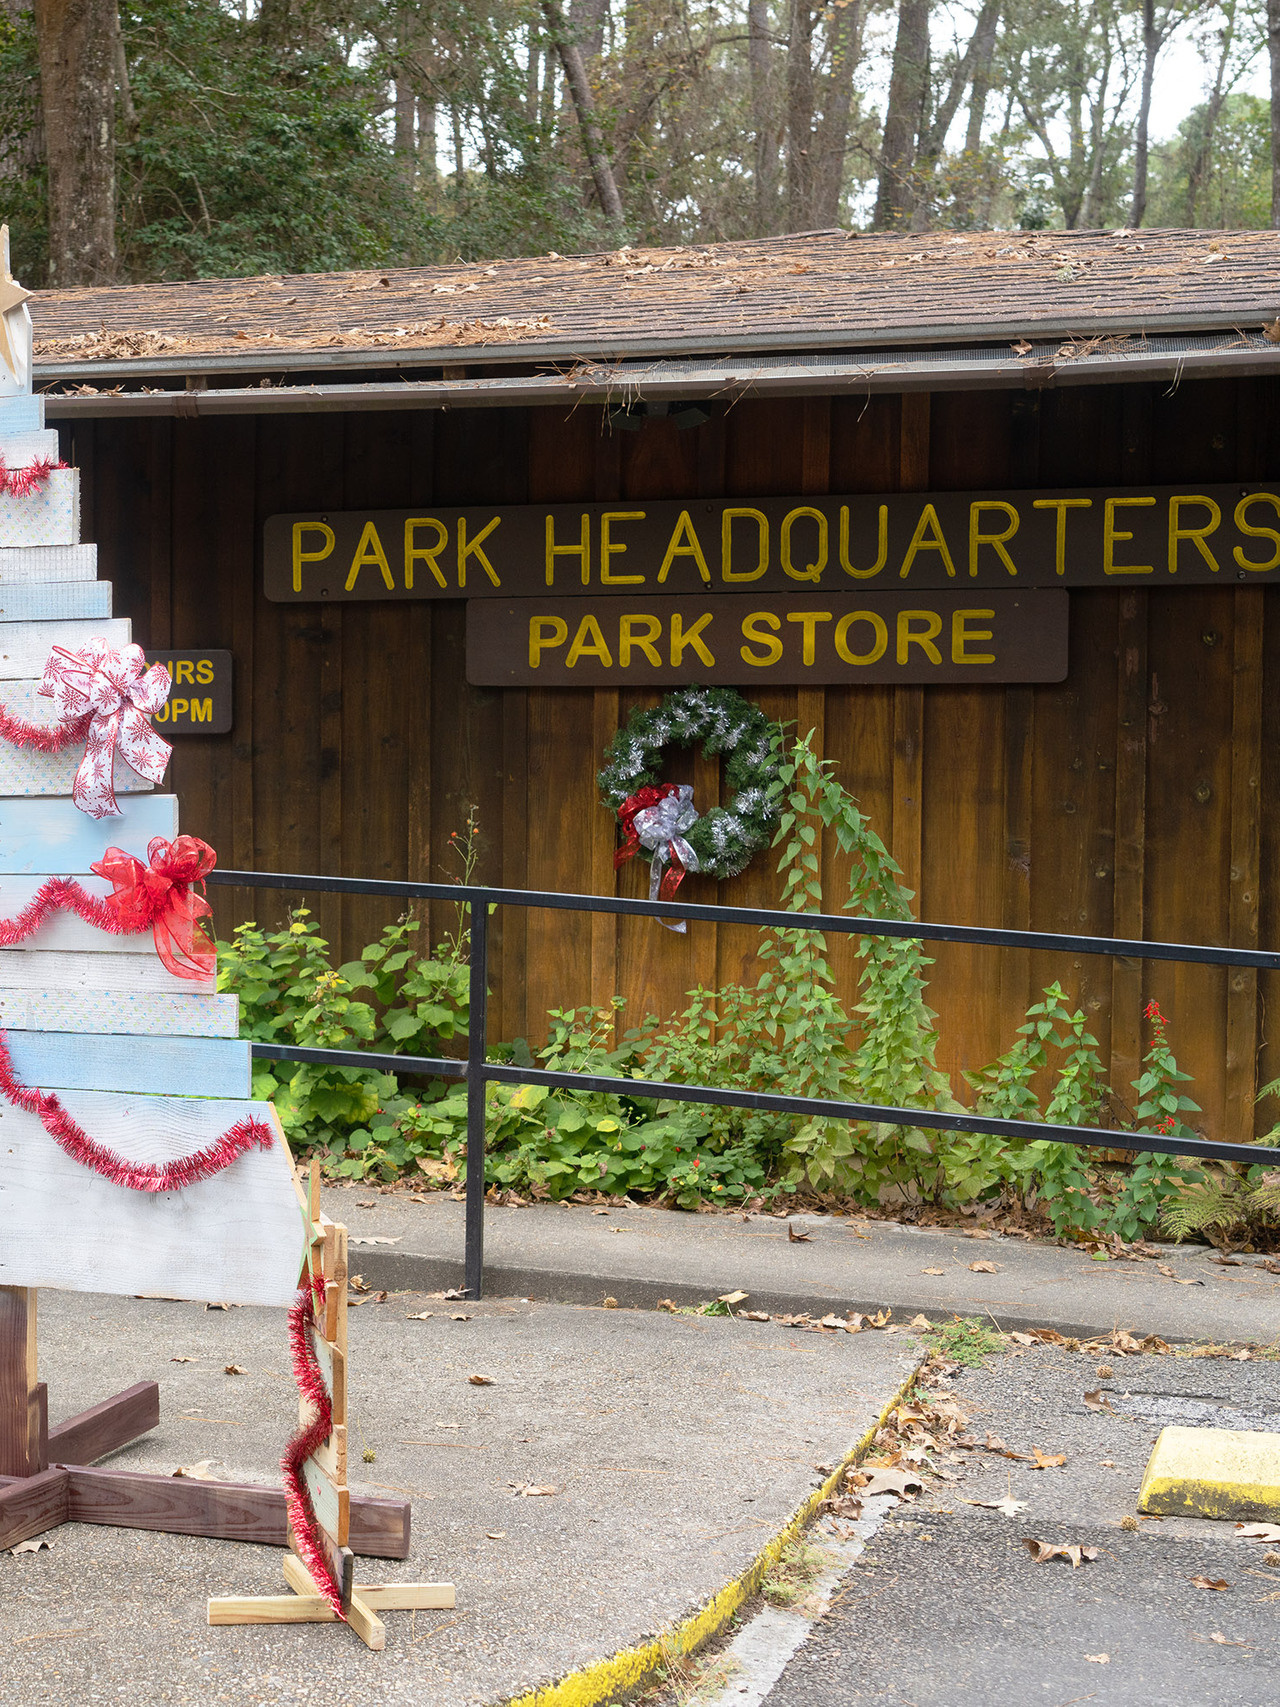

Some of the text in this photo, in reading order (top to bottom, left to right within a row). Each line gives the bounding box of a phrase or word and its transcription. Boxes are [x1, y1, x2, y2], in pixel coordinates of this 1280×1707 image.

[292, 492, 1280, 592] PARK HEADQUARTERS
[528, 609, 996, 669] PARK STORE
